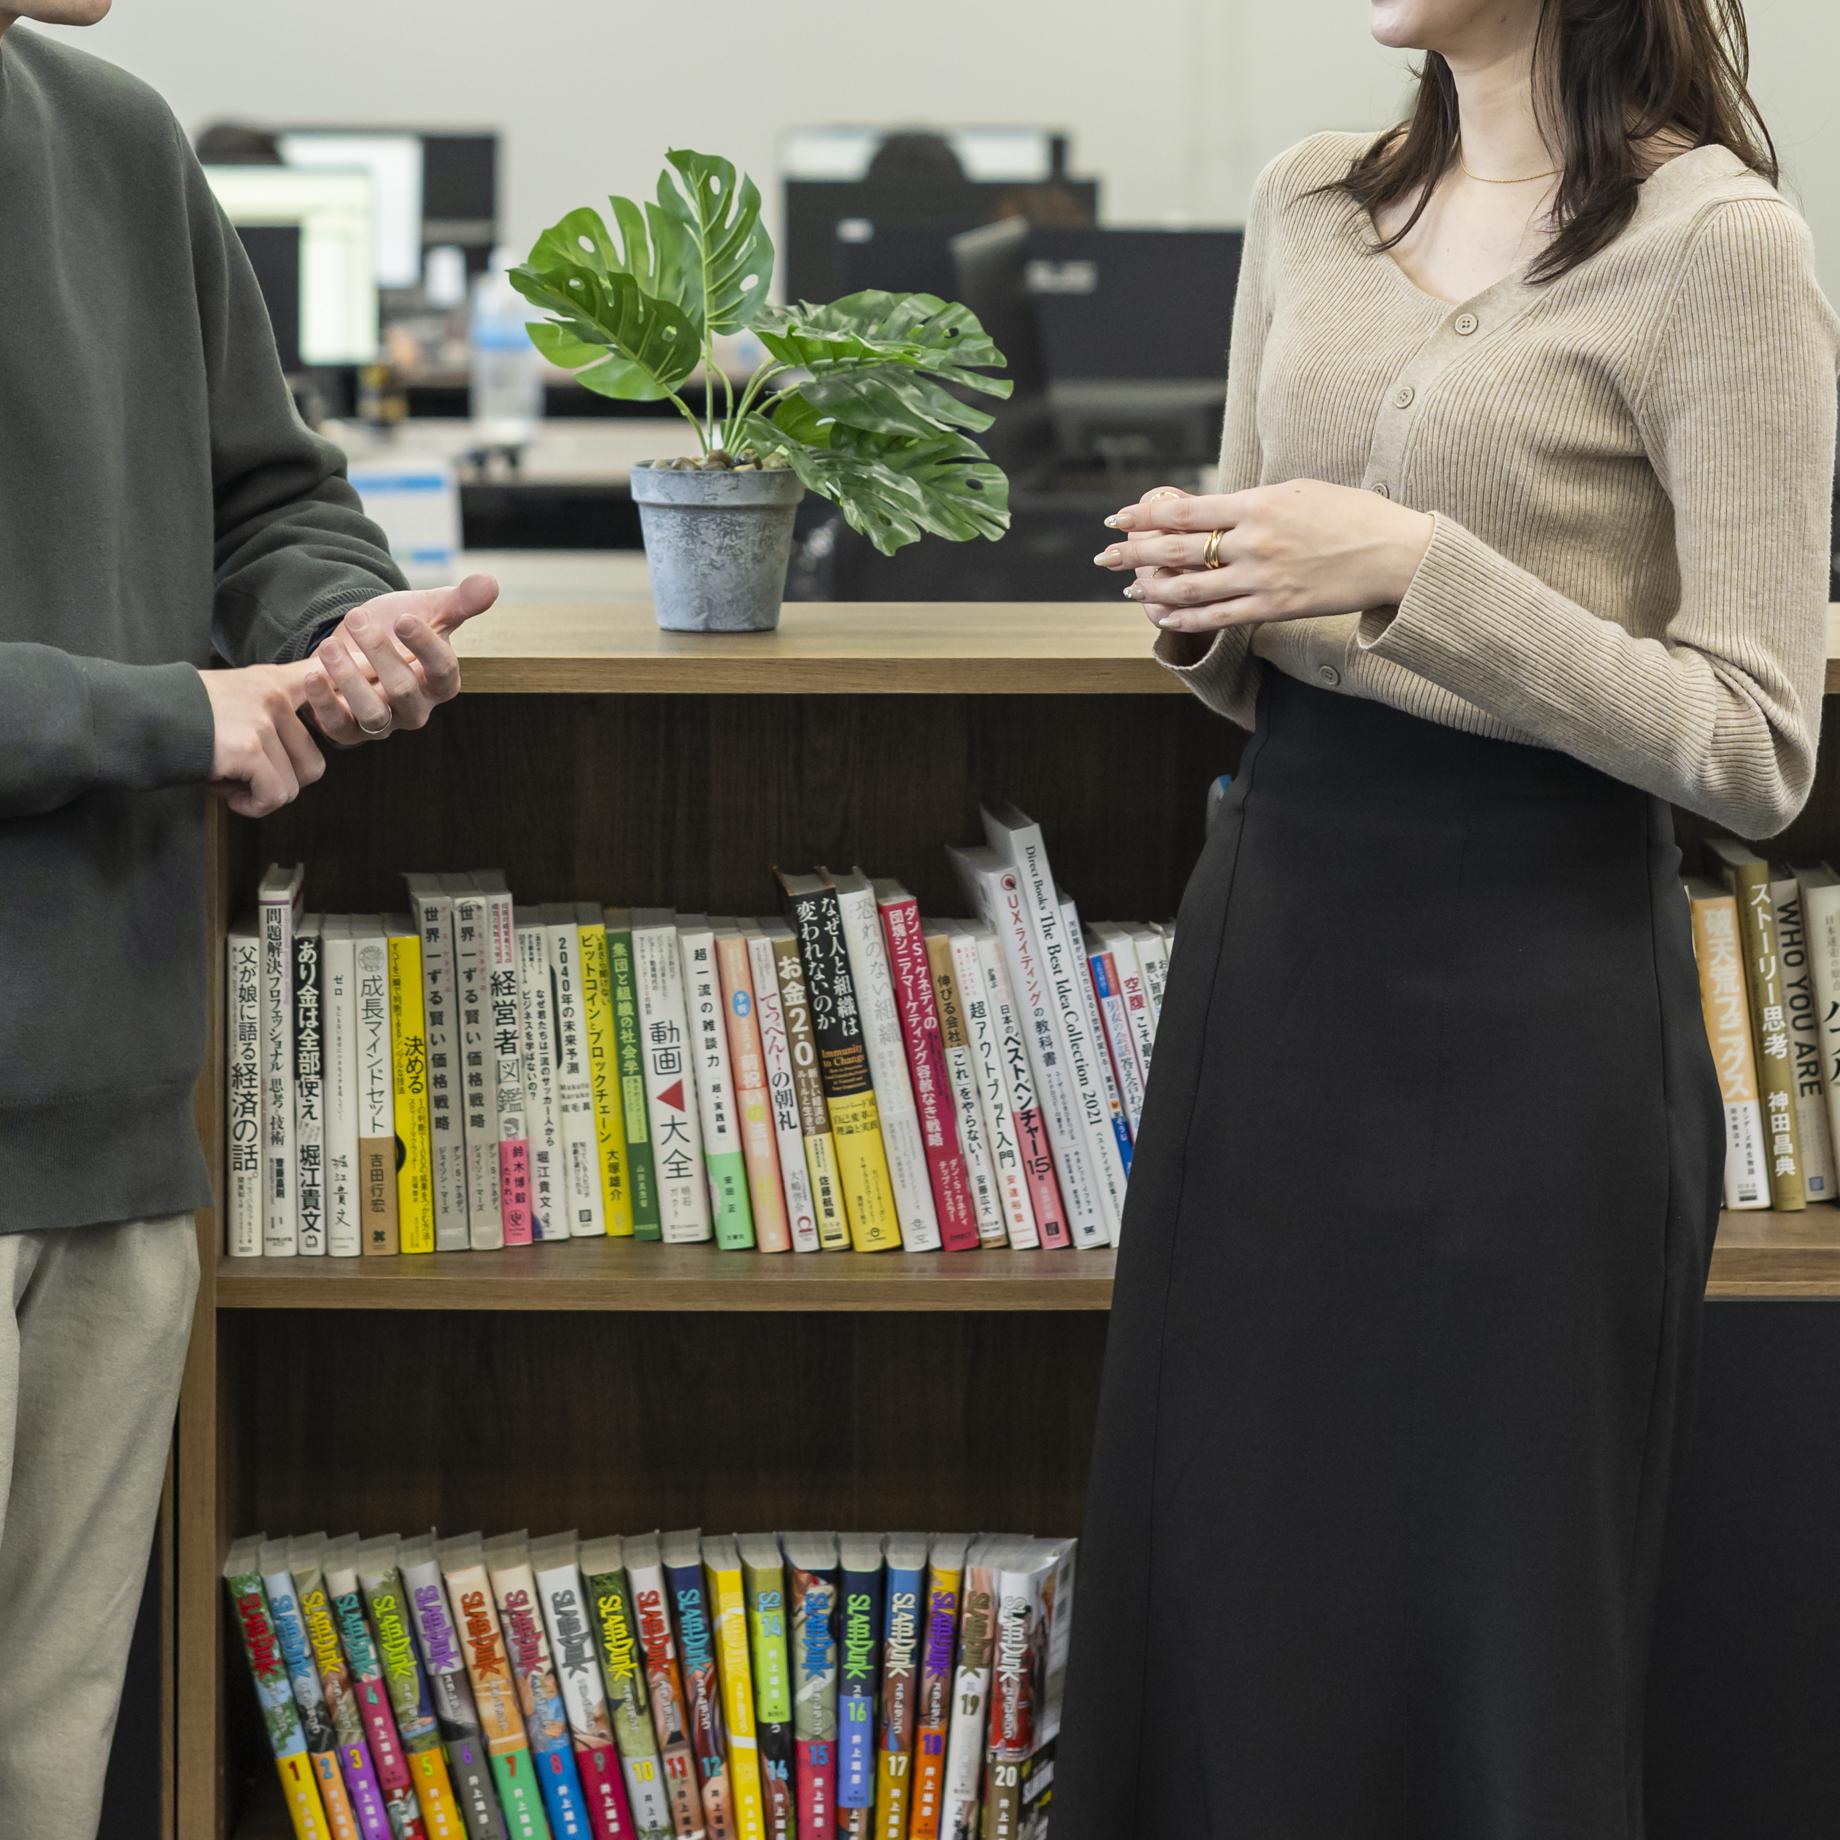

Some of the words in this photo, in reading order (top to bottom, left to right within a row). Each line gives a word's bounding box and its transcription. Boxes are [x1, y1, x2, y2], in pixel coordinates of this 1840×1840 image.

[1025, 845, 1039, 878] Direct
[1033, 879, 1049, 912] Books
[1040, 912, 1057, 940] The
[1047, 944, 1065, 976] Best
[1777, 899, 1806, 968] WHO
[333, 974, 344, 996] ゼロ
[795, 900, 837, 1031] 変われないのか
[820, 897, 860, 1037] なぜ人と組織は
[1006, 894, 1059, 1068] UXライティングの教科書
[1055, 978, 1074, 1011] Idea
[1750, 883, 1789, 1060] ストーリー思考
[296, 940, 321, 1121] あり金は全部使え
[424, 906, 450, 1131] 世界一ずる賢い価格戦略
[459, 906, 486, 1129] 世界一ずる賢い価格戦略
[557, 937, 581, 1075] 2040年の未来予測
[611, 941, 641, 1076] 集団と組織の社会学
[693, 947, 721, 1069] 超一流の雑談力
[778, 956, 815, 1067] お金2.0
[1787, 977, 1815, 1033] YOU
[359, 974, 386, 1134] 成長マインドセット
[403, 1035, 426, 1095] 決める
[648, 1020, 683, 1077] 動画
[760, 993, 798, 1132] てっぺん!の朝礼
[1063, 1010, 1090, 1088] Collection
[1794, 1040, 1824, 1099] ARE
[969, 1000, 1017, 1169] 超アウトプット入門
[1081, 1090, 1104, 1126] 2021
[659, 1114, 695, 1180] 大全
[299, 1144, 322, 1234] 堀江貴文
[848, 1701, 867, 1722] 16
[349, 1748, 363, 1769] 3
[421, 1756, 434, 1777] 5
[632, 1759, 655, 1783] 10
[809, 1744, 829, 1766] 15
[887, 1755, 907, 1776] 17
[995, 1764, 1017, 1788] 20
